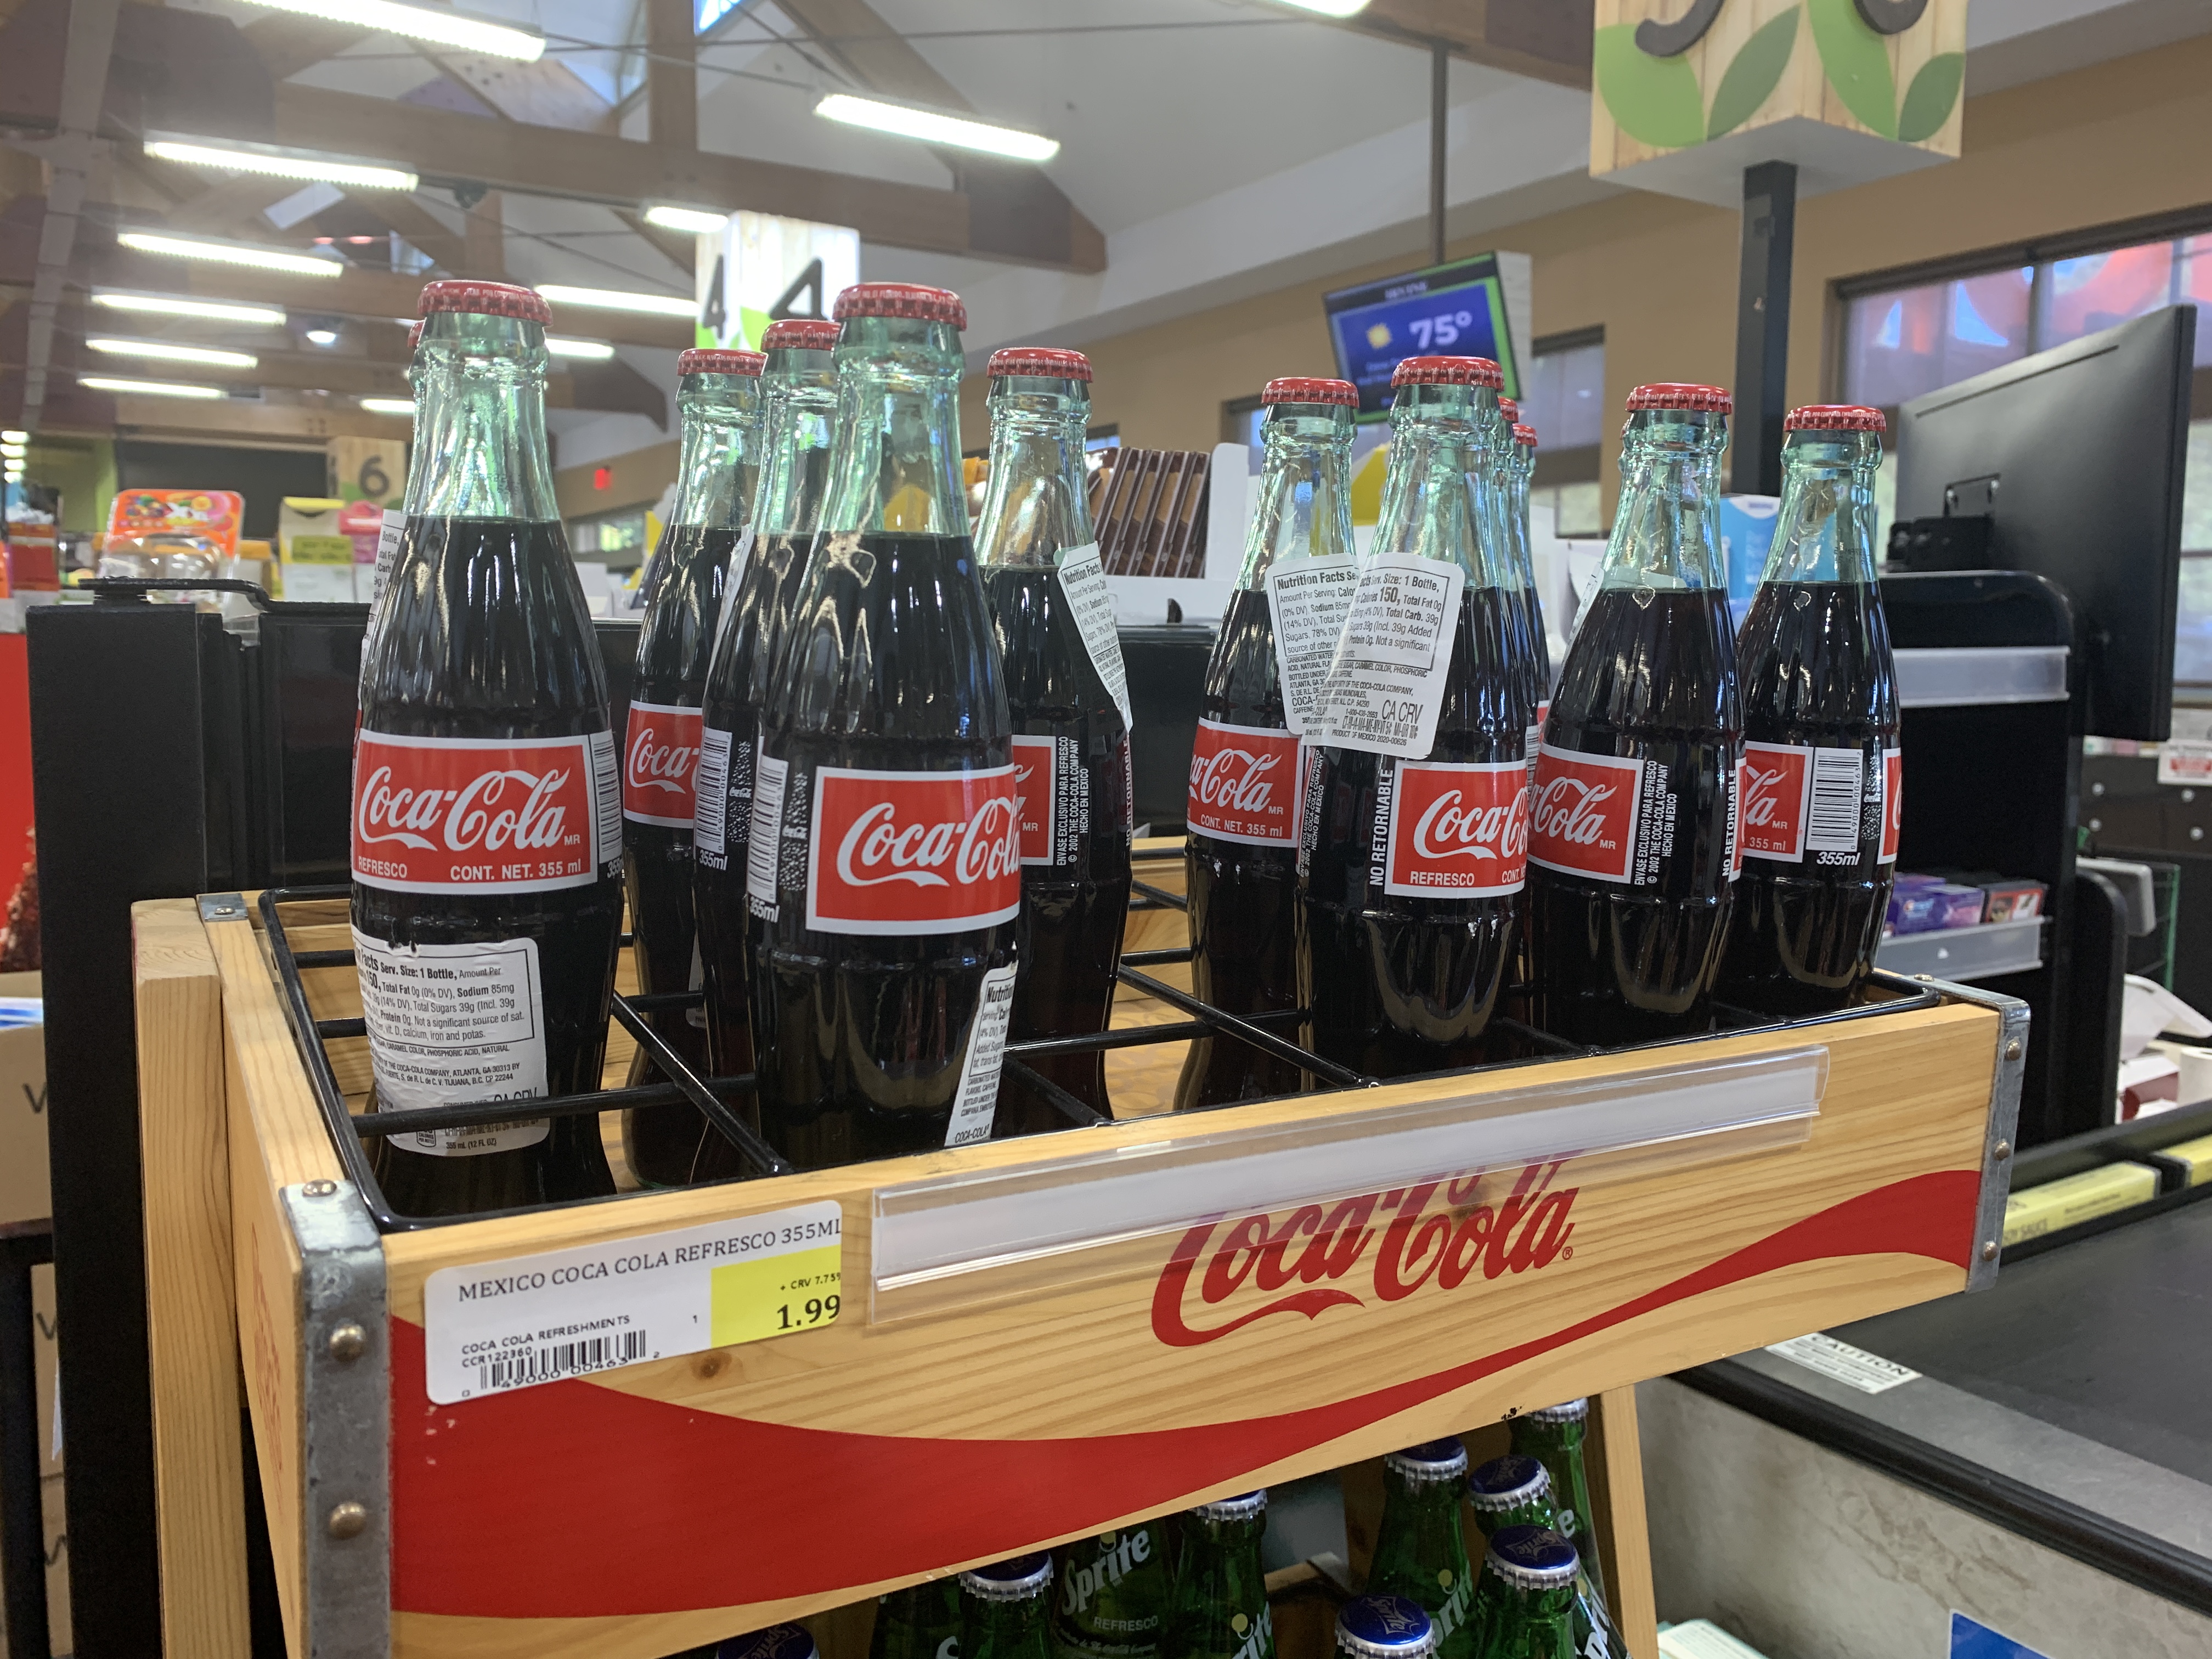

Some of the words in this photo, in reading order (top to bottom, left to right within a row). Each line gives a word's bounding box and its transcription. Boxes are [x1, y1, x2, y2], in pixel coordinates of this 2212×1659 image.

[768, 257, 840, 321] 4
[359, 455, 391, 495] 6
[382, 531, 399, 545] Bottle,
[1064, 569, 1087, 585] Nutrition
[1277, 575, 1318, 590] Nutrition
[1319, 571, 1344, 583] Facts
[1384, 573, 1402, 585] Size:
[1404, 575, 1409, 585] 1
[1412, 576, 1439, 593] Bottle,
[1280, 594, 1302, 603] Amount
[1304, 591, 1313, 599] Per
[1314, 589, 1336, 598] Serving:
[1380, 586, 1401, 606] 150,
[1404, 595, 1420, 606] Total
[1421, 597, 1432, 608] Fat
[1434, 600, 1442, 612] 0g
[1282, 608, 1294, 619] (0%
[1311, 603, 1334, 612] Sodium
[1386, 607, 1403, 618] Total
[1404, 610, 1423, 622] Carb.
[1426, 613, 1438, 626] 39g
[1284, 619, 1301, 631] (14%
[1319, 616, 1335, 624] Total
[1391, 622, 1406, 635] 39g
[1407, 625, 1432, 637] Added
[1285, 633, 1311, 642] Sugars,
[1312, 629, 1327, 637] 78%
[1375, 635, 1387, 646] Not
[1394, 638, 1430, 652] significant
[1286, 654, 1317, 663] CARBONATED
[1375, 664, 1392, 673] COLOR,
[1393, 665, 1427, 678] PHOSPHORIC
[1290, 680, 1311, 689] ATLANTA,
[1360, 681, 1386, 691] COCA-COLA
[1386, 685, 1413, 696] COMPANY,
[1382, 699, 1396, 720] CA
[1398, 702, 1424, 724] CRV
[1059, 736, 1069, 775] REFRESCO
[1070, 739, 1079, 775] COMPANY
[1059, 776, 1069, 795] PARA
[1080, 768, 1089, 796] MEXICO
[1644, 760, 1657, 798] REFRESCO
[1656, 764, 1669, 799] COMPANY
[1070, 776, 1079, 817] COCA-COLA
[1080, 797, 1088, 807] EN
[359, 766, 571, 851] Coca-Cola
[1268, 806, 1283, 815] MR
[1372, 768, 1393, 862] RETORNABLE
[1642, 799, 1654, 818] PARA
[1666, 793, 1677, 820] MEXICO
[1725, 769, 1736, 857] RETORNABLE
[1058, 797, 1069, 837] EXCLUSIVO
[1070, 818, 1079, 832] THE
[1080, 808, 1088, 833] HECHO
[1201, 814, 1221, 829] CONT.
[1224, 820, 1243, 833] NET.
[1246, 823, 1266, 835] 355
[1269, 826, 1282, 837] ml
[1652, 798, 1664, 839] COCA-COLA
[1772, 820, 1788, 830] MR
[1023, 822, 1039, 832] MR
[564, 834, 580, 846] MR
[1070, 834, 1078, 851] 2002
[1600, 839, 1616, 850] MR
[1638, 819, 1651, 857] EXCLUSIVO
[1662, 832, 1672, 857] HECHO
[1750, 837, 1769, 849] 355
[1773, 840, 1786, 851] ml
[699, 849, 728, 871] 355ml
[1057, 838, 1067, 865] ENVASE
[1816, 851, 1861, 866] 355ml
[358, 856, 408, 878] REFRESCO
[450, 865, 494, 882] CONT.
[501, 863, 533, 879] NET.
[538, 861, 563, 877] 355
[567, 857, 582, 874] ml
[1369, 866, 1384, 886] NO
[1634, 857, 1648, 885] ENVASE
[1722, 859, 1731, 877] NO
[1410, 871, 1475, 886] REFRESCO
[1502, 870, 1520, 883] CONT.
[381, 962, 398, 975] Serv.
[400, 965, 418, 978] Size:
[420, 968, 424, 978] 1
[427, 969, 458, 981] Bottle,
[459, 969, 488, 979] Amount
[489, 967, 501, 976] Per
[382, 981, 398, 993] Total
[400, 985, 410, 995] Fat
[411, 986, 420, 998] 0g
[422, 988, 436, 998] (0%
[457, 988, 489, 997] Sodium
[491, 984, 515, 994] 85mg
[381, 996, 395, 1008] (14%
[413, 1000, 429, 1012] Total
[431, 1003, 457, 1015] Sugars
[459, 1003, 475, 1013] 39g
[499, 998, 515, 1009] 39g
[381, 1009, 400, 1023] Protein
[414, 1015, 425, 1026] Not
[432, 1014, 471, 1029] significant
[472, 1014, 499, 1025] source
[500, 1012, 509, 1022] of
[403, 1029, 429, 1041] calcium,
[430, 1030, 444, 1041] iron
[445, 1030, 460, 1041] and
[462, 1030, 486, 1042] potas.
[427, 1048, 462, 1057] PHOSPHORIC
[464, 1048, 481, 1056] ACID,
[482, 1045, 510, 1054] NATURAL
[397, 1064, 424, 1074] COCA-COLA
[424, 1068, 452, 1077] COMPANY,
[495, 1073, 514, 1082] 22244
[458, 1272, 546, 1303] MEXICO
[551, 1262, 610, 1286] COCA
[614, 1252, 670, 1275] COLA
[674, 1230, 777, 1266] REFRESCO
[781, 1218, 841, 1244] 355ML
[791, 1278, 811, 1289] CRV
[777, 1294, 840, 1330] 1.99
[462, 1341, 498, 1356] COCA
[501, 1333, 534, 1347] COLA
[538, 1314, 631, 1340] REFRESHMENTS
[462, 1346, 533, 1368] CCR122360
[501, 1370, 560, 1389] 49000
[571, 1357, 628, 1374] 00463
[1062, 1530, 1150, 1616] Sprite
[1094, 1615, 1158, 1632] REFRESCO
